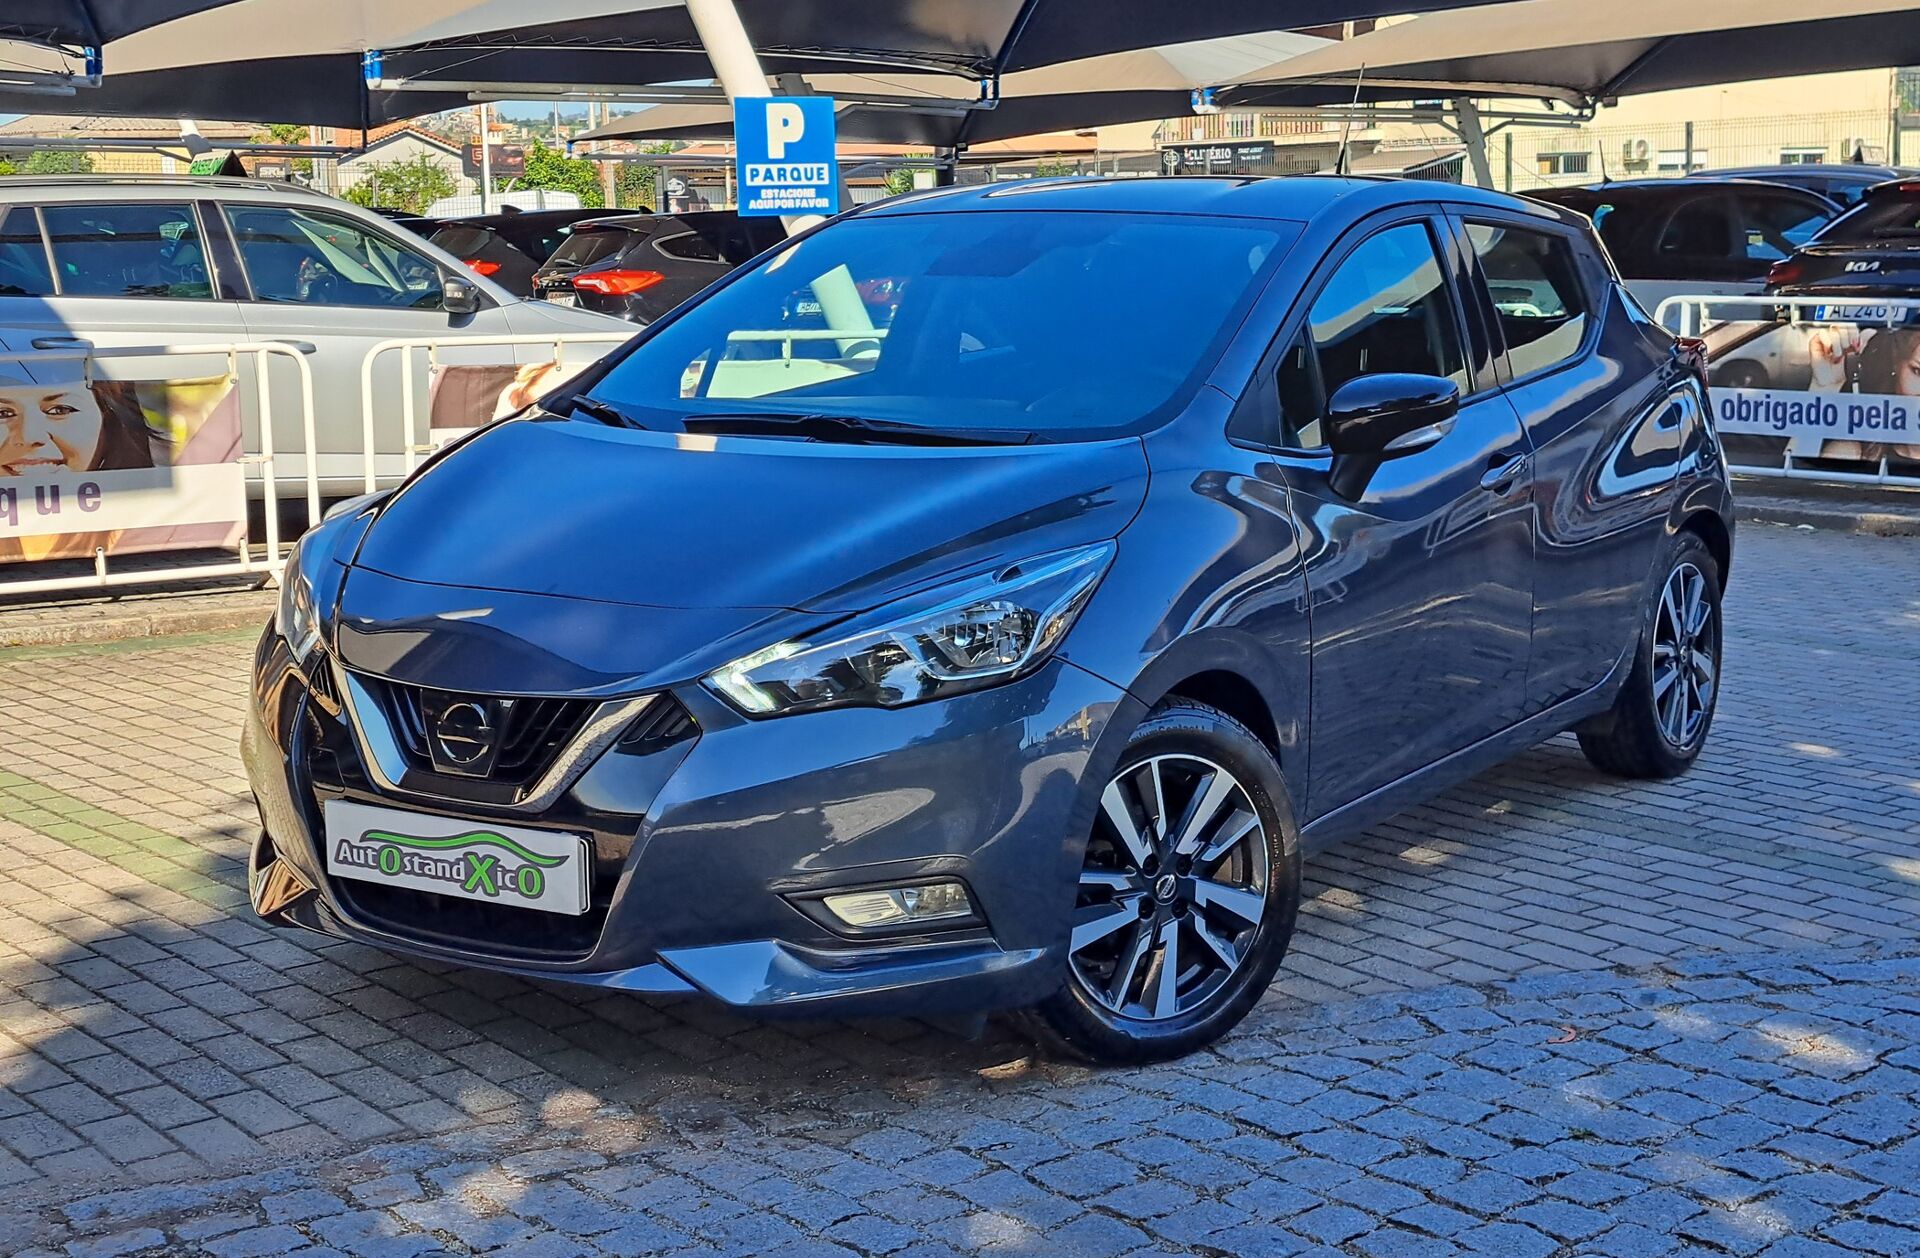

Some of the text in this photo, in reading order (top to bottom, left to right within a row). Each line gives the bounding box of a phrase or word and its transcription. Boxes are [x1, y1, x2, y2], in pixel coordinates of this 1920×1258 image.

[766, 103, 805, 159] P
[749, 166, 826, 183] PARQUE
[761, 187, 816, 200] ESTACIONE
[748, 198, 830, 210] AQUI POR FAVOR
[1720, 393, 1838, 431] obrigado
[1848, 400, 1906, 434] pela
